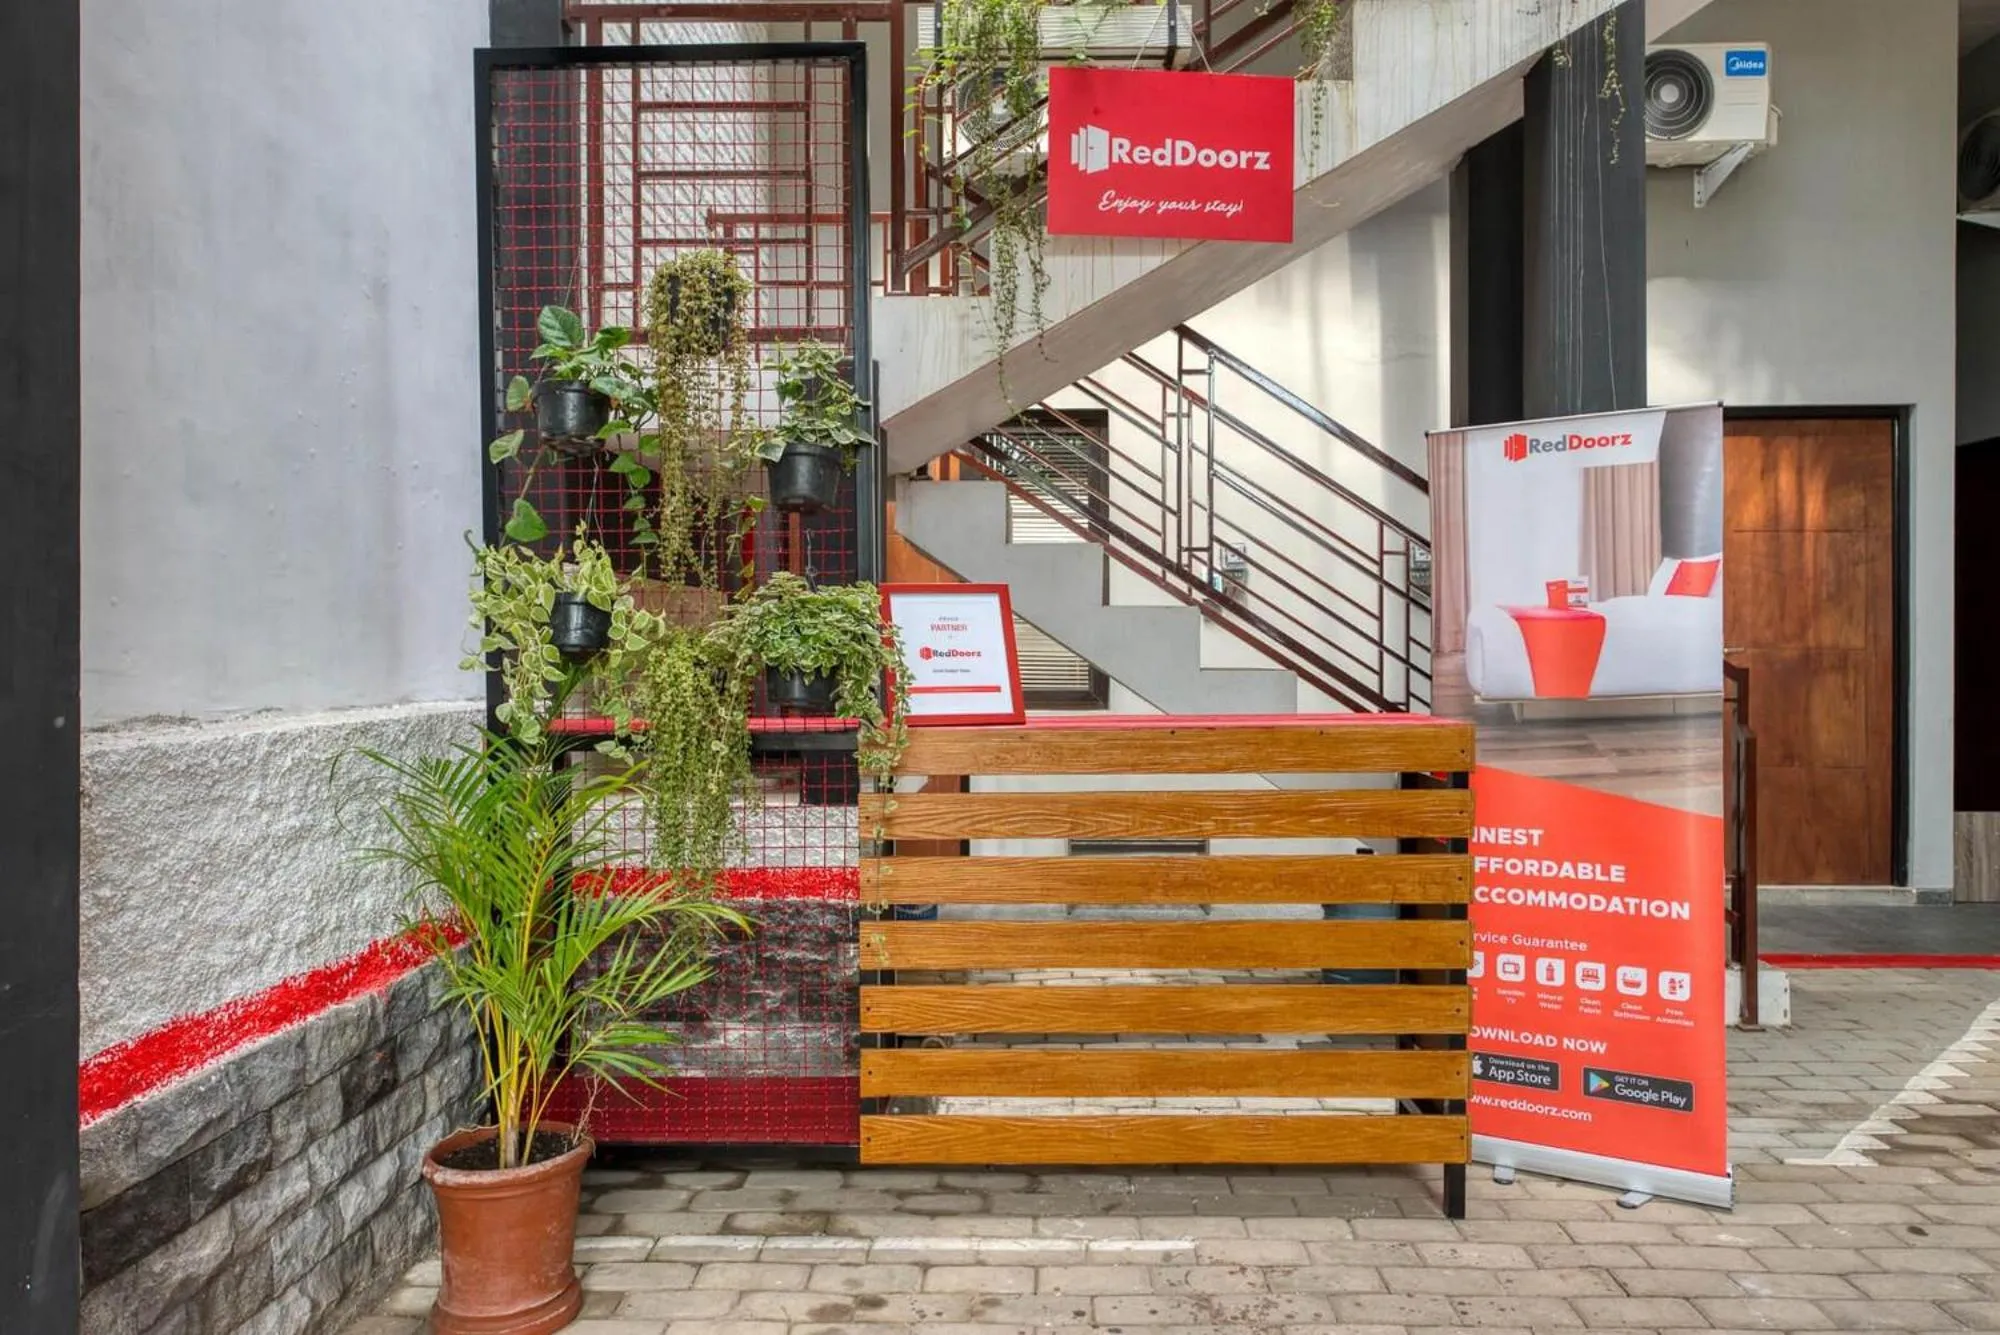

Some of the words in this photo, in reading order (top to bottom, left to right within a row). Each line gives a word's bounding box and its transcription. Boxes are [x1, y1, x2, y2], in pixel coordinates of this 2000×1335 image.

[1731, 59, 1764, 70] Midea
[1111, 137, 1271, 170] RedDoorz
[1099, 189, 1154, 214] Enjoy
[1156, 199, 1201, 214] your
[1528, 433, 1632, 455] RedDoorz
[932, 648, 981, 658] RedDoorz
[1472, 826, 1544, 847] INEST
[1473, 856, 1626, 883] FFORDABLE
[1474, 886, 1690, 921] CCOMMODATION
[1473, 931, 1508, 945] rvice
[1512, 934, 1588, 952] Guarantee
[1470, 1025, 1558, 1048] OWNLOAD
[1562, 1036, 1607, 1054] NOW
[1488, 1057, 1525, 1069] Download
[1488, 1066, 1515, 1082] App
[1516, 1069, 1552, 1086] Store
[1614, 1083, 1660, 1102] Google
[1661, 1090, 1687, 1108] Play
[1471, 1094, 1593, 1121] ww.reddoorz.com
